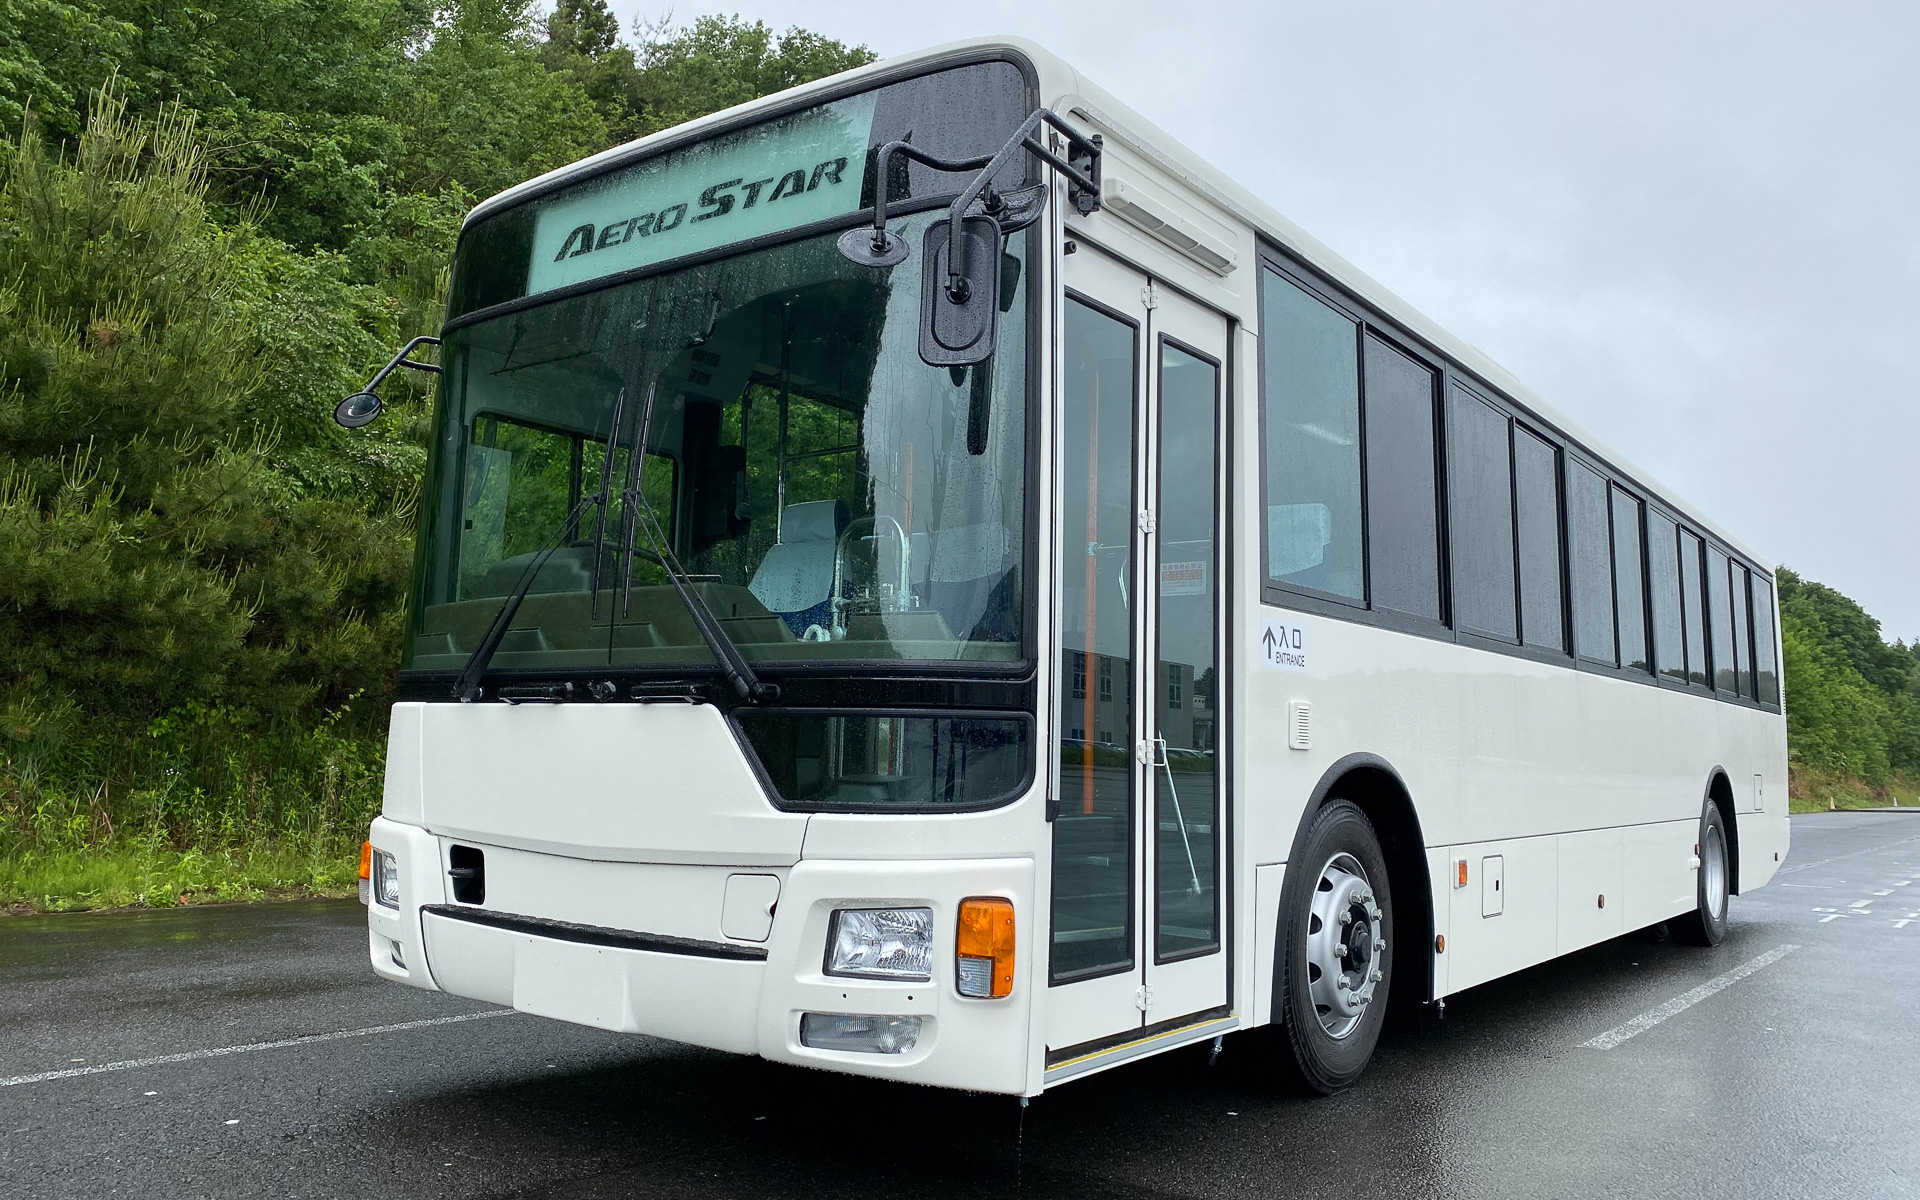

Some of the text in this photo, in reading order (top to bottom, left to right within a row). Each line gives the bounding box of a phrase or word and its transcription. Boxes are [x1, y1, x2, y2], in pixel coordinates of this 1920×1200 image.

[553, 157, 848, 262] AERO STAR
[1279, 625, 1301, 649] 入口
[1276, 651, 1305, 667] ENTRANCE
